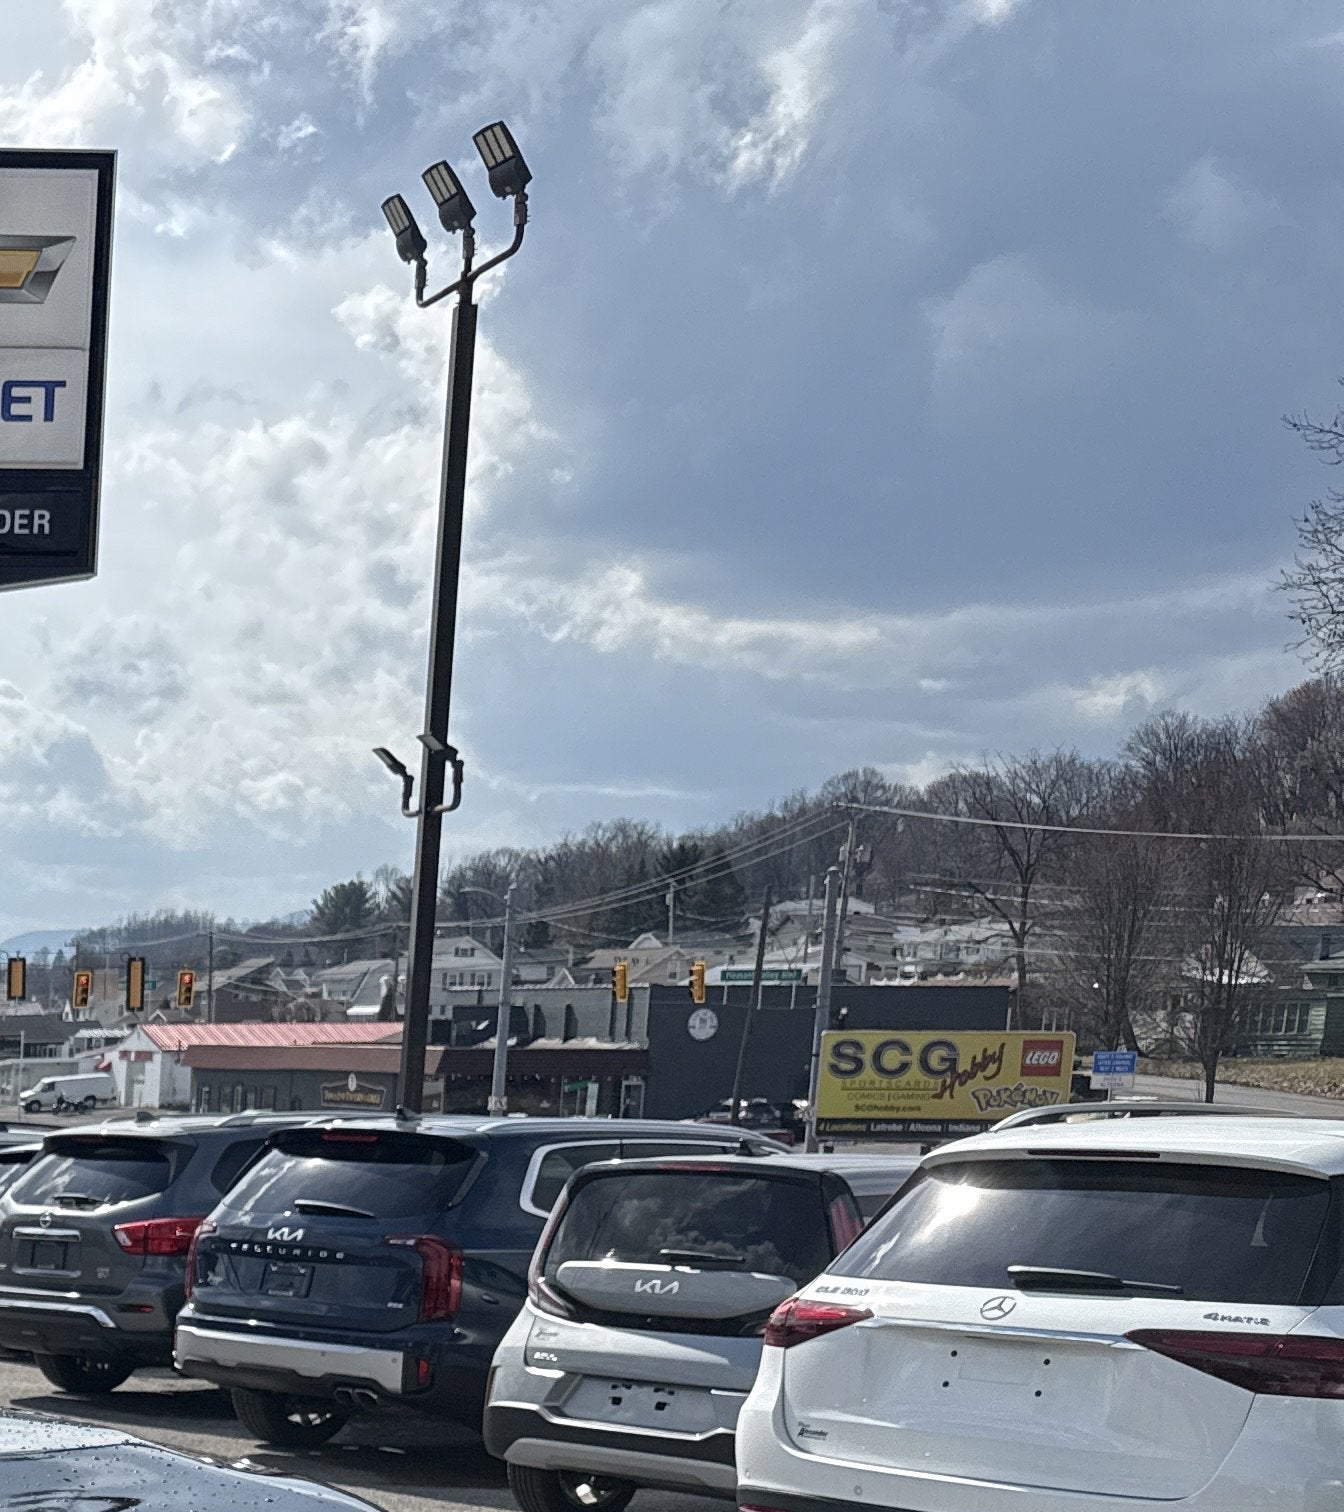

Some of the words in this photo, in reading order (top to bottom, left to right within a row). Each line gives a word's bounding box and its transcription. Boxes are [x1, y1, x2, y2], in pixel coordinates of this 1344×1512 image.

[1024, 1050, 1060, 1065] LEGO
[828, 1039, 960, 1079] SCG
[931, 1042, 1006, 1100] Hobby
[267, 1227, 305, 1242] KIA
[634, 1279, 680, 1295] KIA
